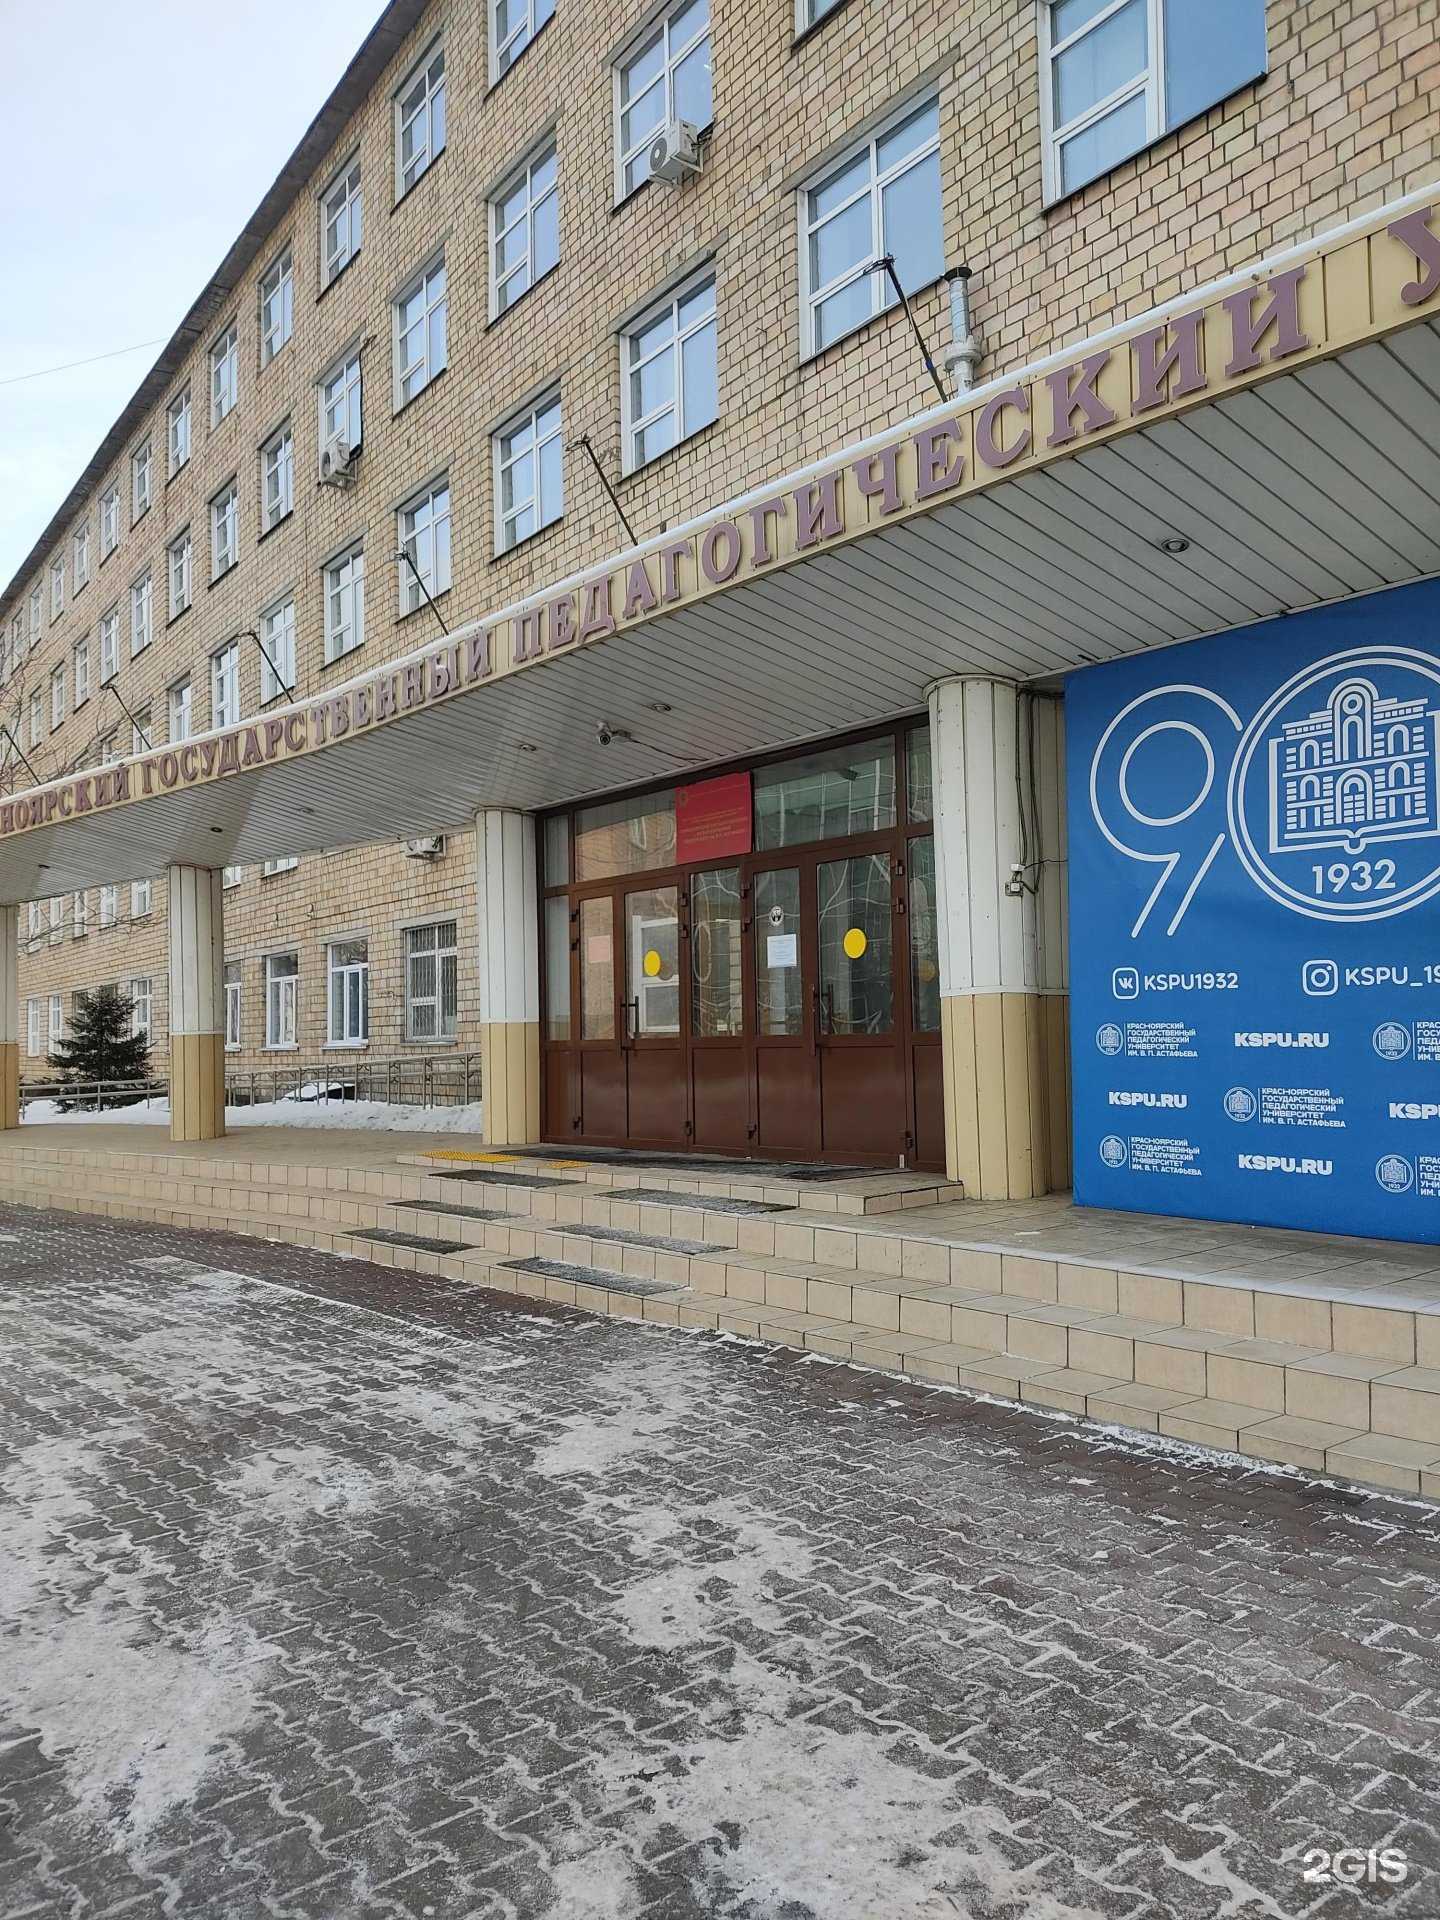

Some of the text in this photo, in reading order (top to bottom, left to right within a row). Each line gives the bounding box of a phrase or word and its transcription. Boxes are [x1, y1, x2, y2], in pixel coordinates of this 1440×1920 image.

[1311, 859, 1396, 894] 1932
[1144, 972, 1239, 991] KSPU1932
[1234, 1032, 1329, 1048] KSPU.RU
[1108, 1091, 1187, 1108] KSPU.RU
[1262, 1087, 1330, 1096] КРАСНОЯРСКИЙ
[1262, 1095, 1344, 1105] ГОСУДАРСТВЕННЫЙ
[1262, 1102, 1336, 1112] ПЕДАГОГИЧЕСКИЙ
[1262, 1110, 1324, 1119] УНИВЕРСИТЕТ
[1389, 1103, 1440, 1119] KSP
[1278, 1117, 1286, 1125] В.
[1297, 1118, 1346, 1128] АСТАФЬЕВА
[1238, 1154, 1333, 1175] KSPU.RU
